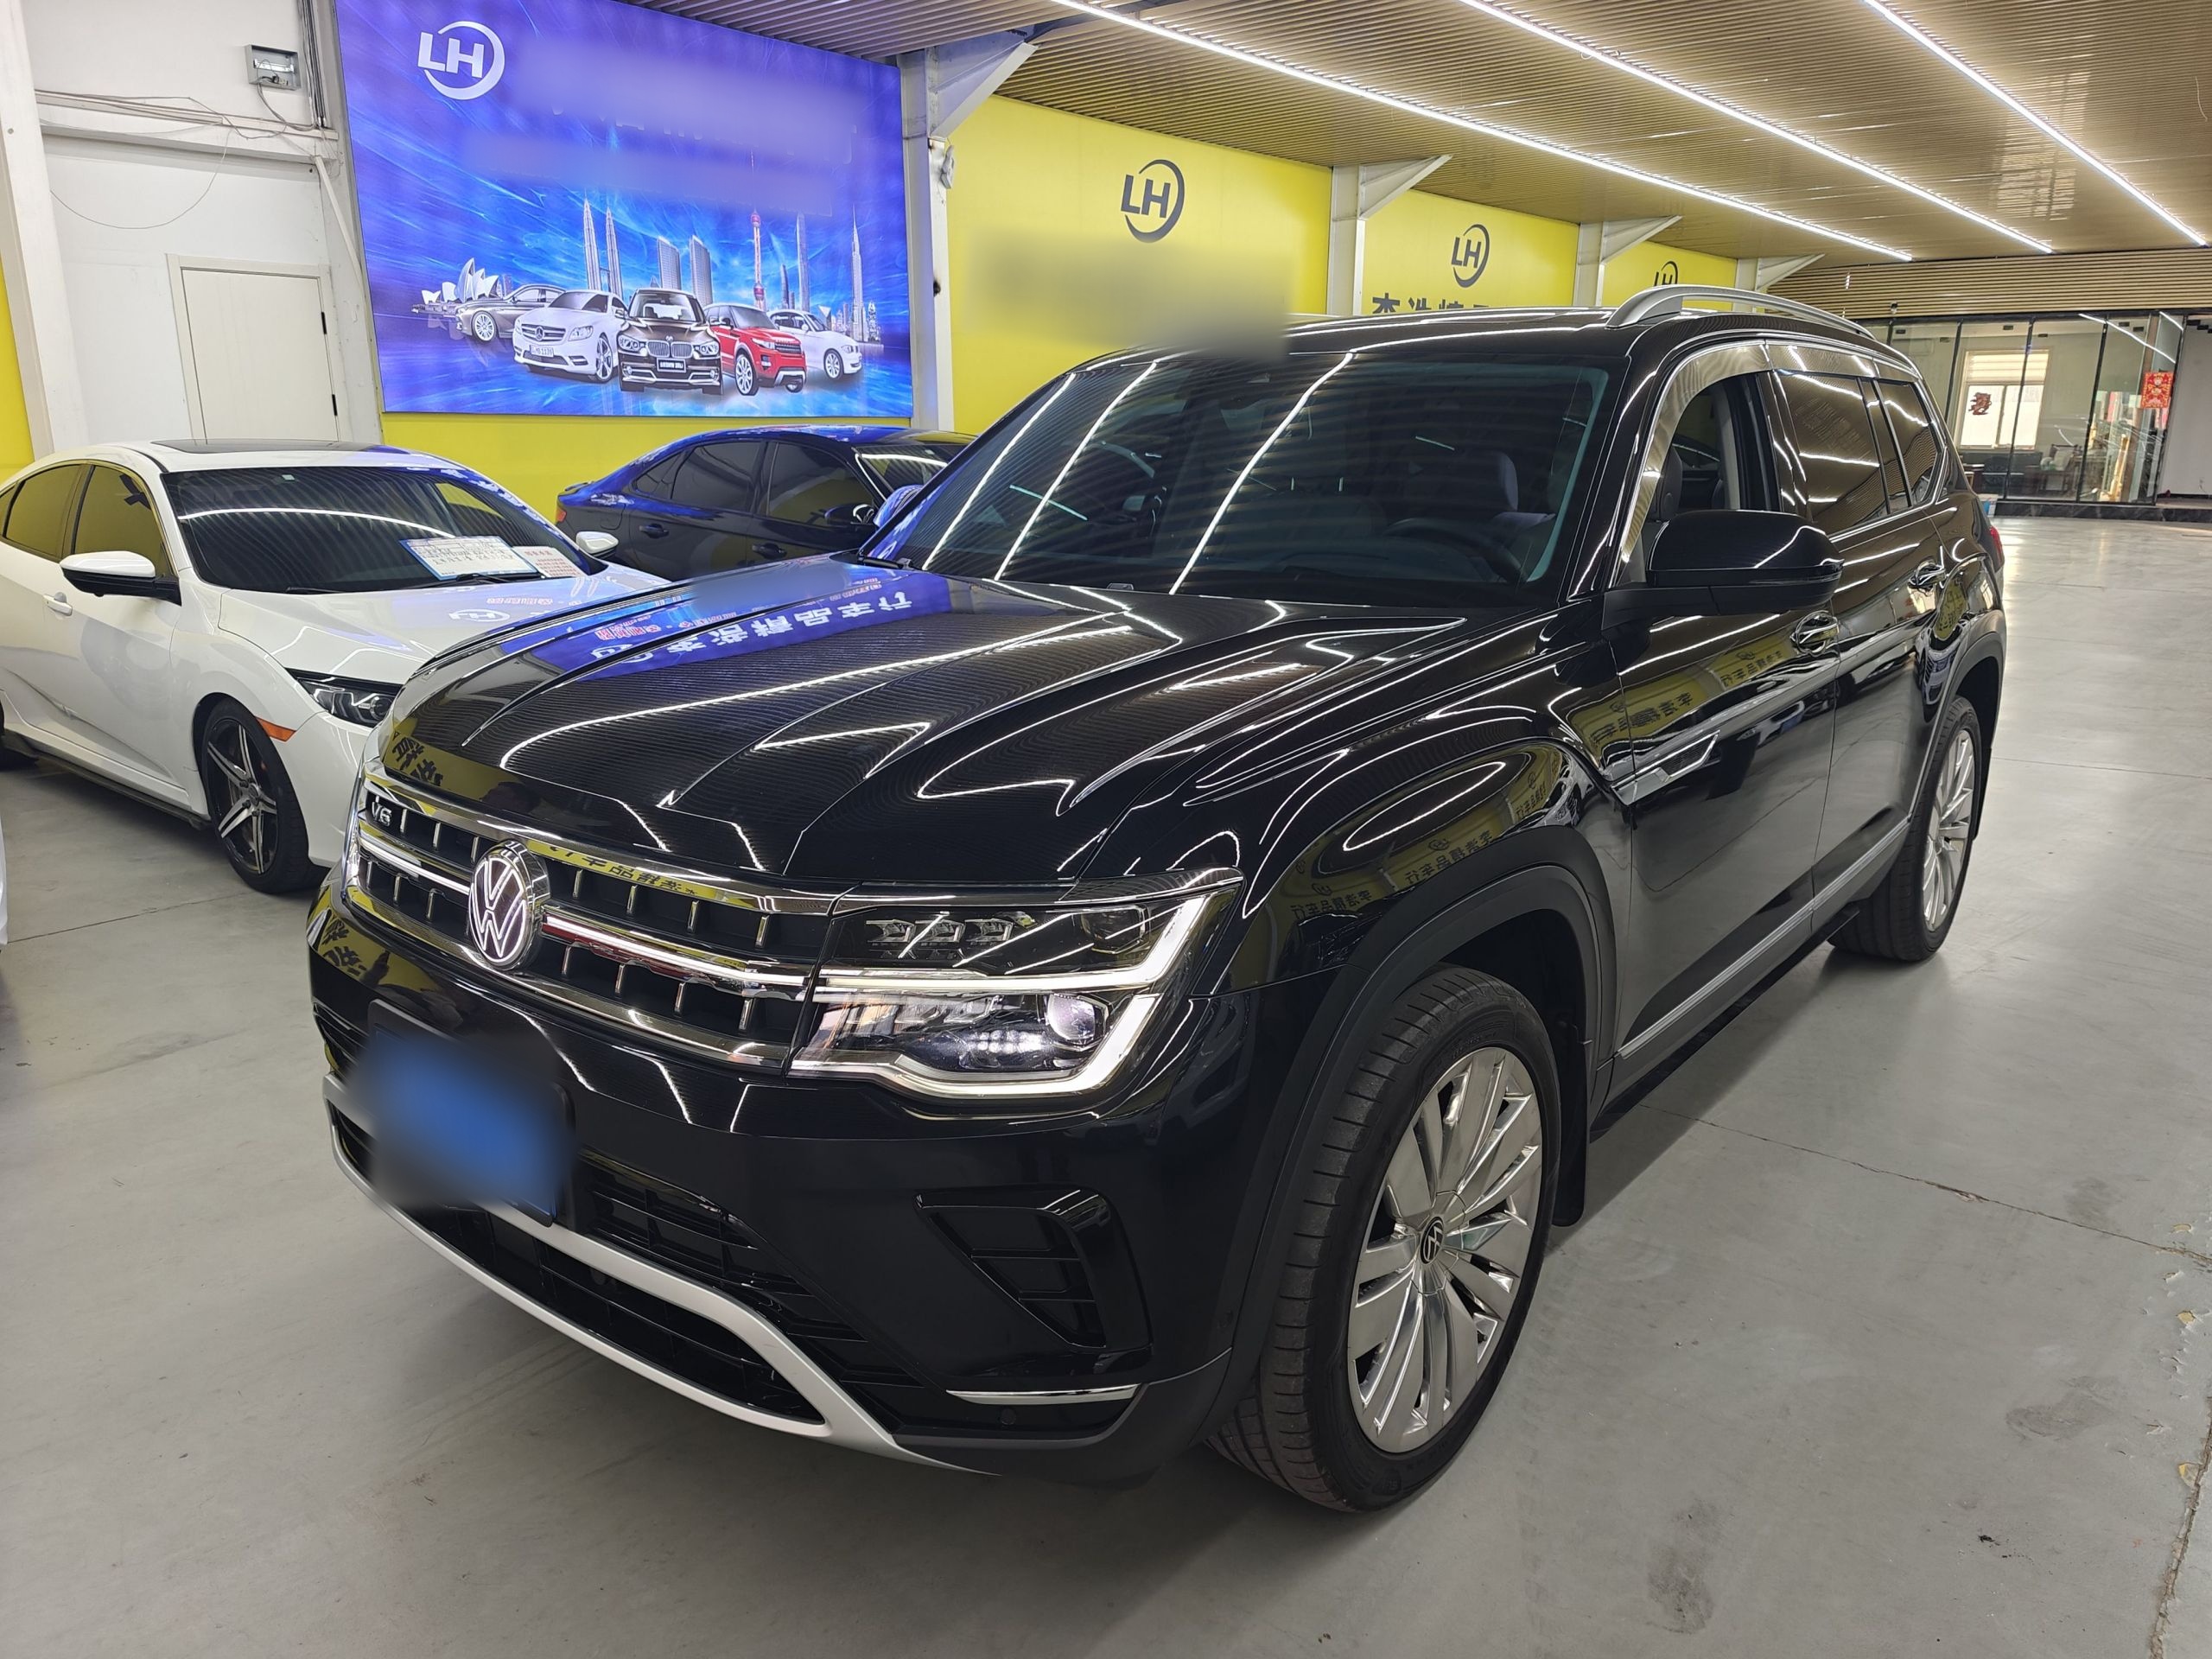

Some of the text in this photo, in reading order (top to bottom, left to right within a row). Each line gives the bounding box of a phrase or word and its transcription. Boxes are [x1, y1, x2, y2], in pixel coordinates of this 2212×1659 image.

[418, 32, 485, 79] LH
[1121, 174, 1171, 218] LH
[372, 801, 391, 826] V6
